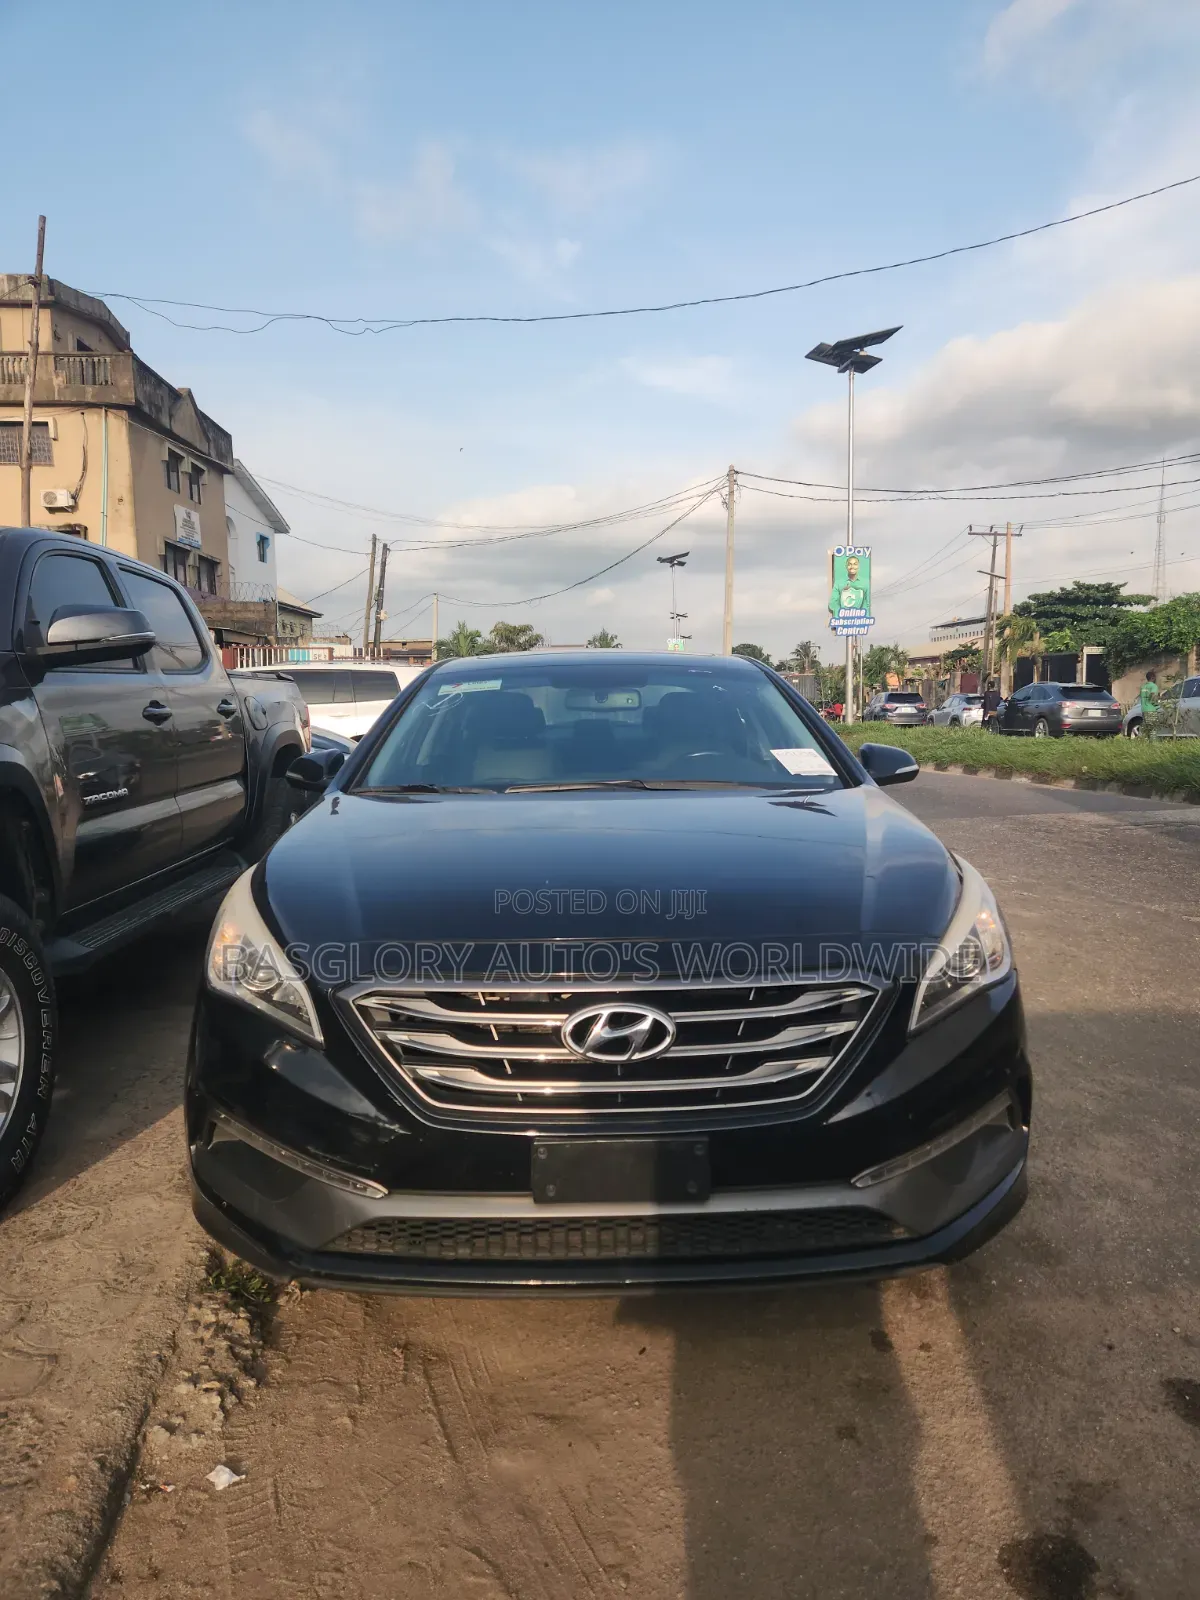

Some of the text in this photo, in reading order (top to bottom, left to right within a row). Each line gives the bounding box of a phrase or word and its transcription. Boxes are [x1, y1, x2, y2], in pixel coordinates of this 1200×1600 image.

[834, 545, 872, 558] OPay
[839, 609, 866, 617] Online
[830, 618, 874, 626] Subscription
[837, 626, 868, 635] Control
[83, 788, 129, 805] TACOMA
